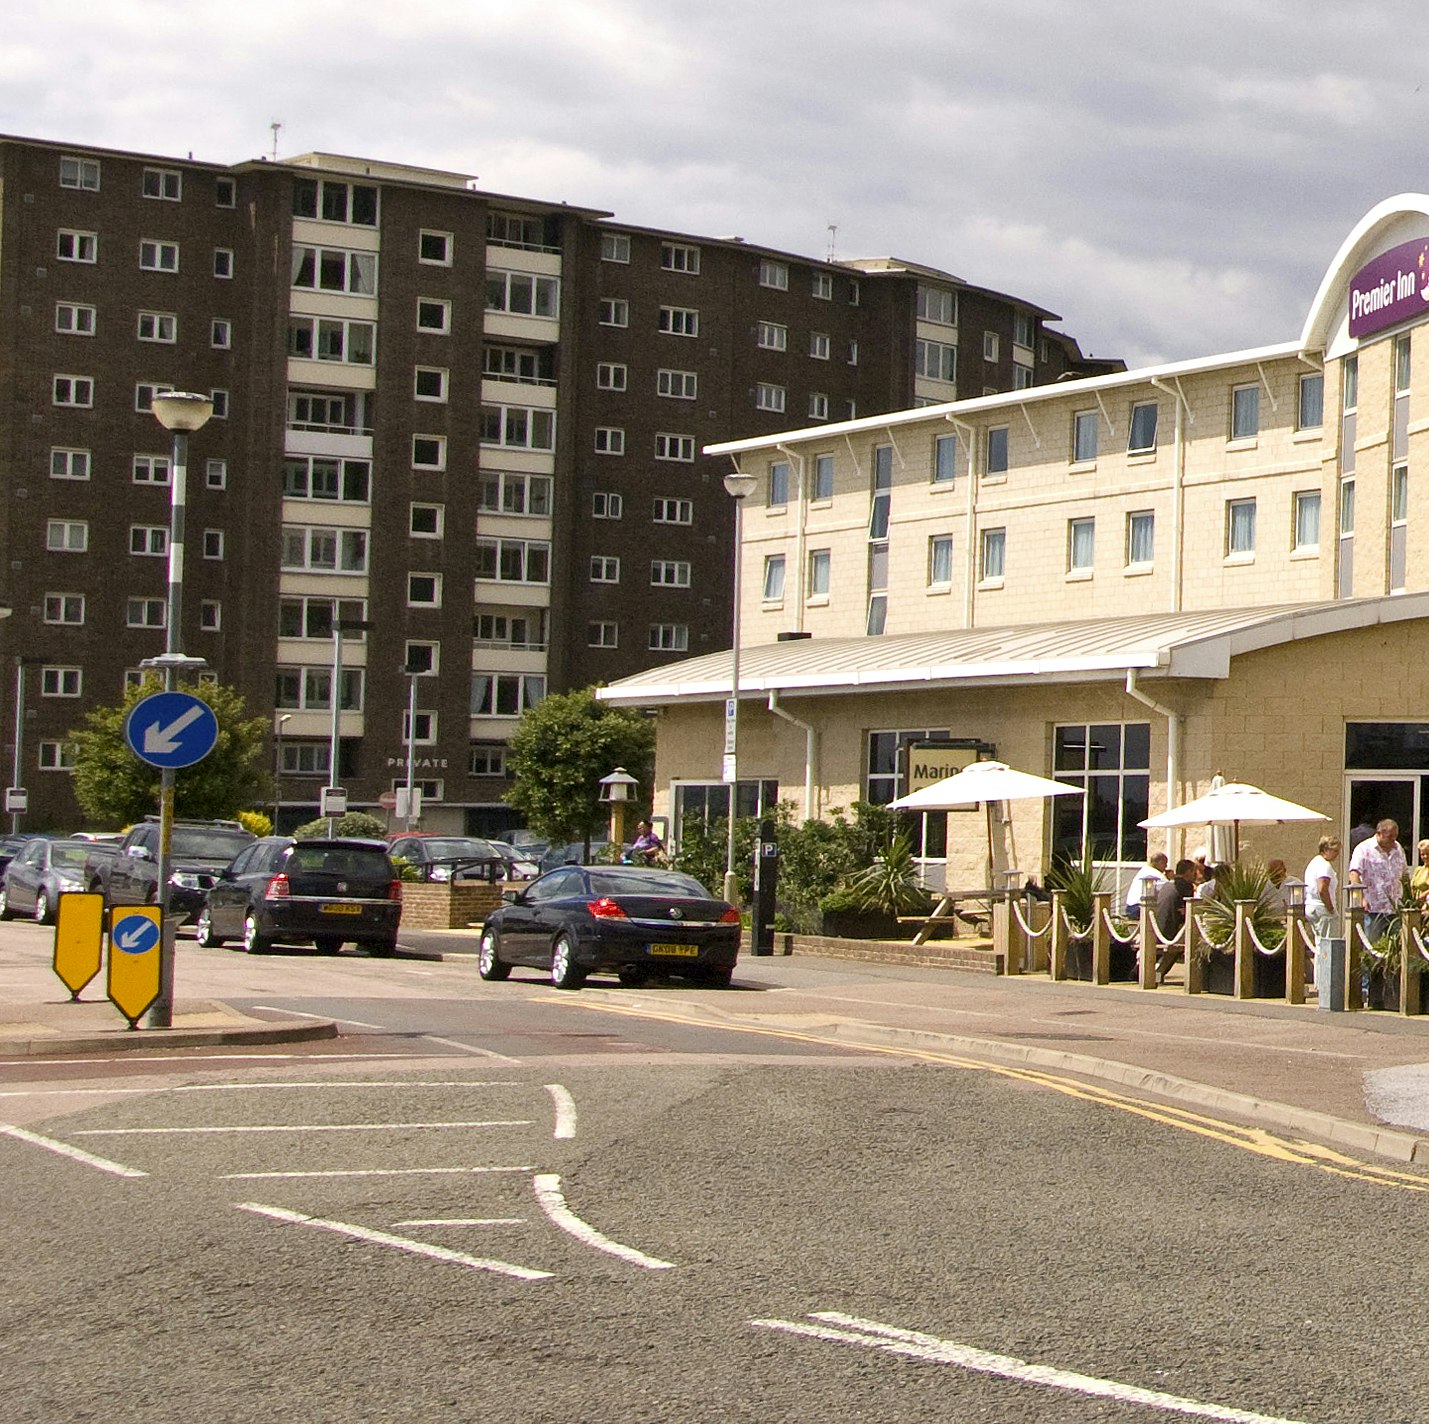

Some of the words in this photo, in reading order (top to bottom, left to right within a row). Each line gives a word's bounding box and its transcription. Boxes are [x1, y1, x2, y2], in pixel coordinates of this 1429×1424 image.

[1352, 278, 1396, 320] Premier
[1397, 270, 1415, 300] Inn
[913, 763, 964, 779] Marin
